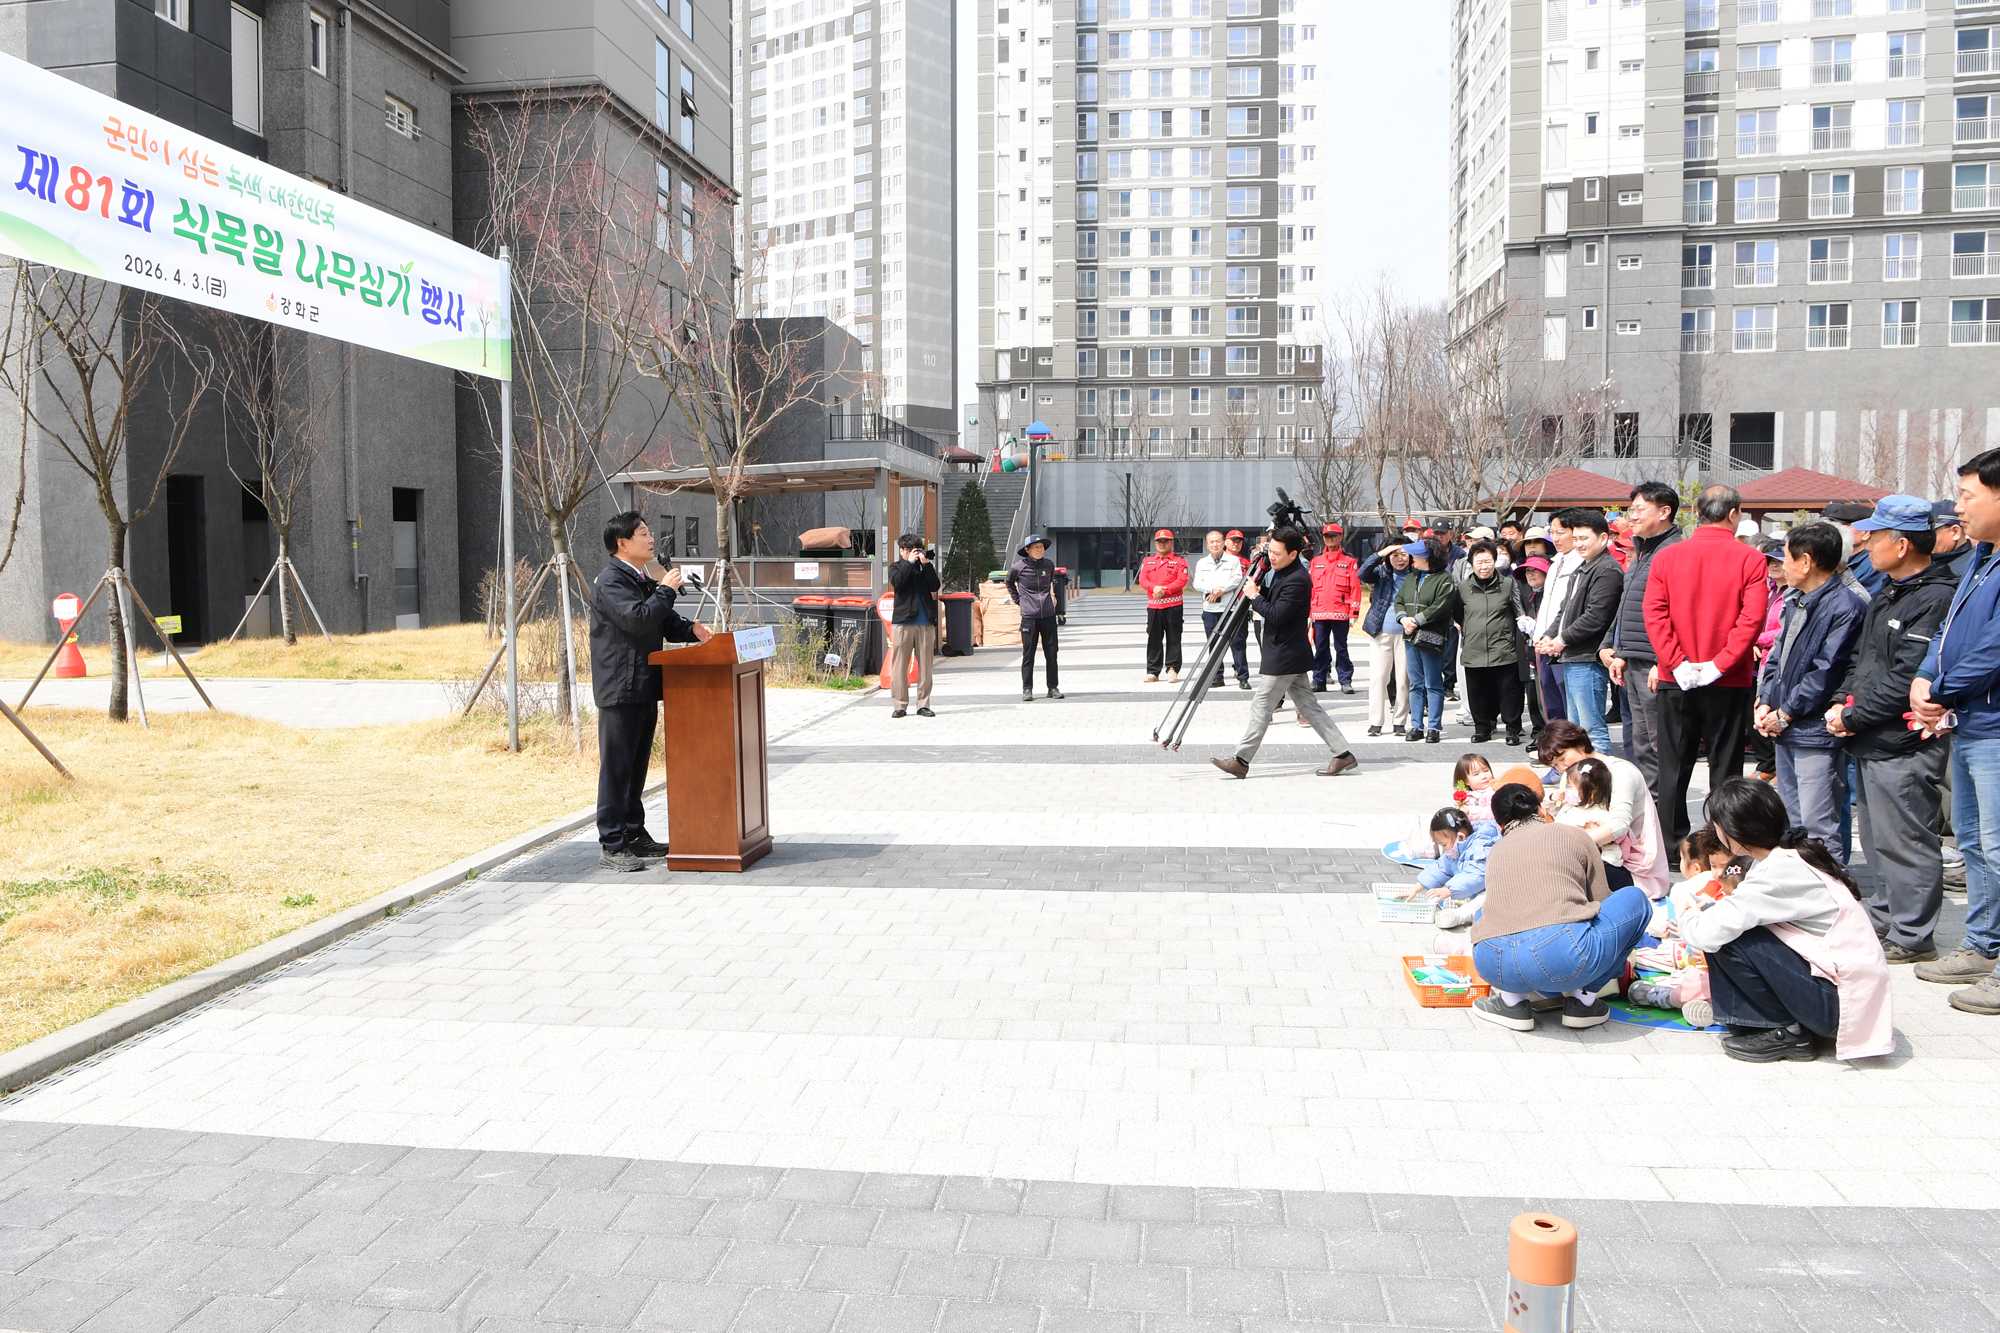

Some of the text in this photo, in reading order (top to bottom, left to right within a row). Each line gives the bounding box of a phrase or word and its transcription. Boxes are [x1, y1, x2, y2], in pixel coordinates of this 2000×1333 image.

[103, 116, 335, 231] 군민이 심는 녹색 대한민국
[14, 144, 466, 331] 제81회 식목일 나무심기 행사
[124, 254, 227, 299] 2026. 4. 3.(금)
[281, 297, 320, 323] 강화군
[923, 354, 936, 366] 110
